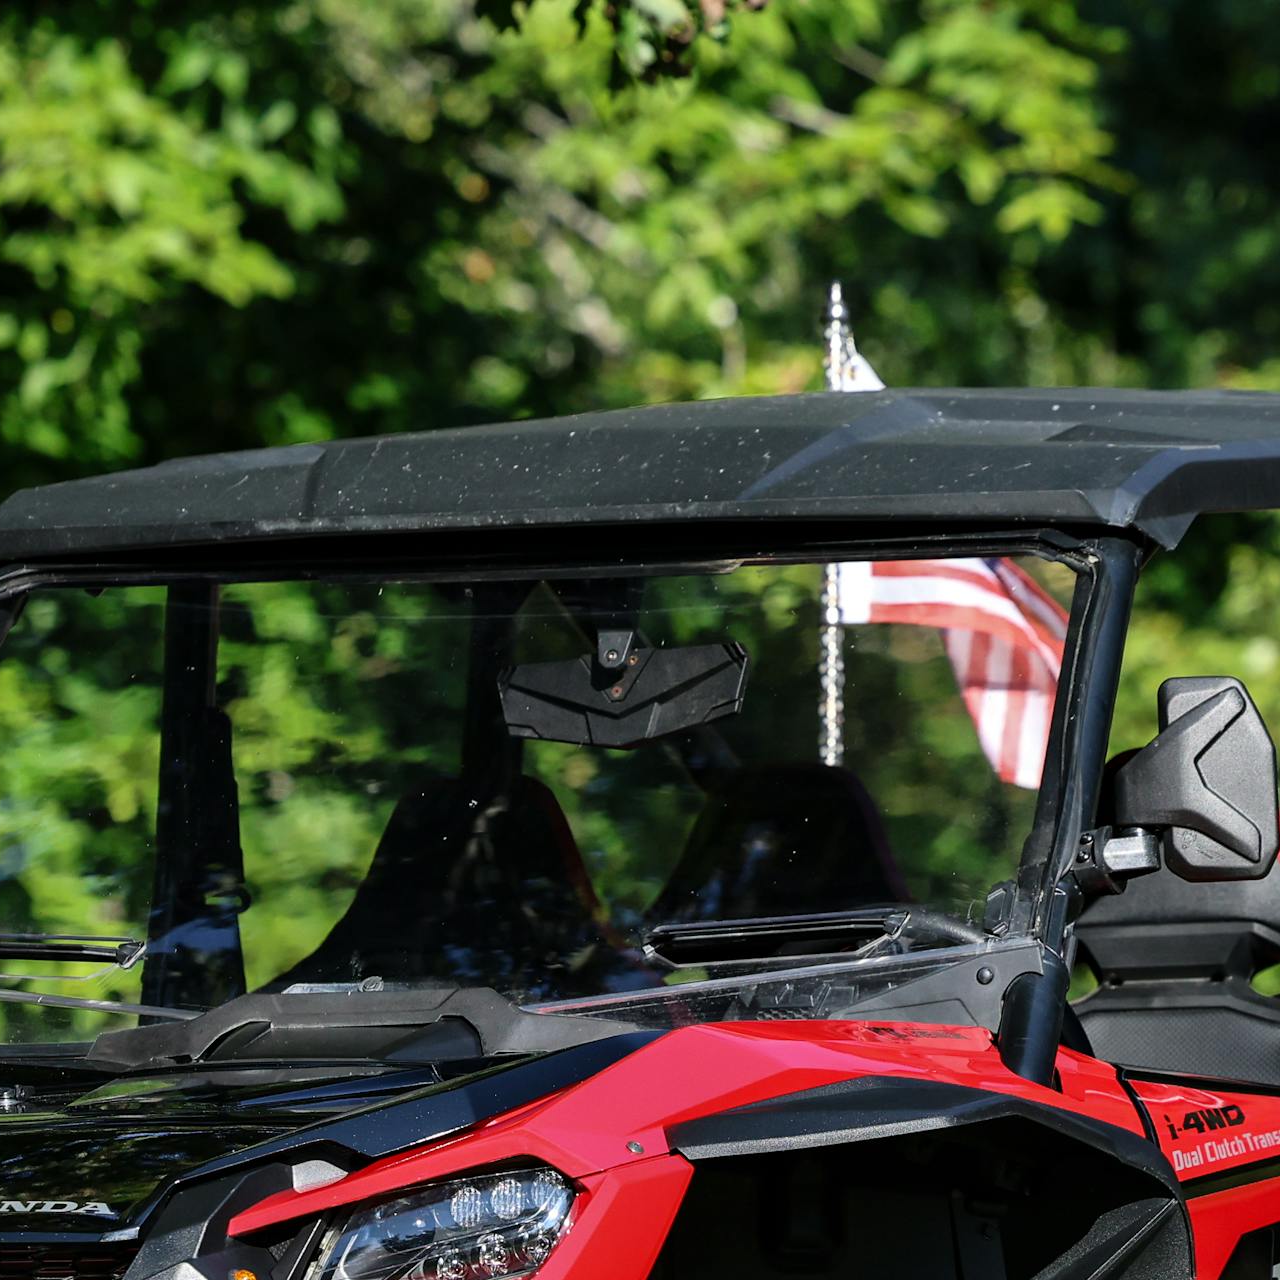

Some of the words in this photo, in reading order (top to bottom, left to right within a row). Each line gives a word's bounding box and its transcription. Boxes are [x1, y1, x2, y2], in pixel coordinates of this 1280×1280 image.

[1165, 1105, 1245, 1140] i-4WD
[1172, 1145, 1204, 1171] Dual
[1206, 1136, 1247, 1162] Clutch
